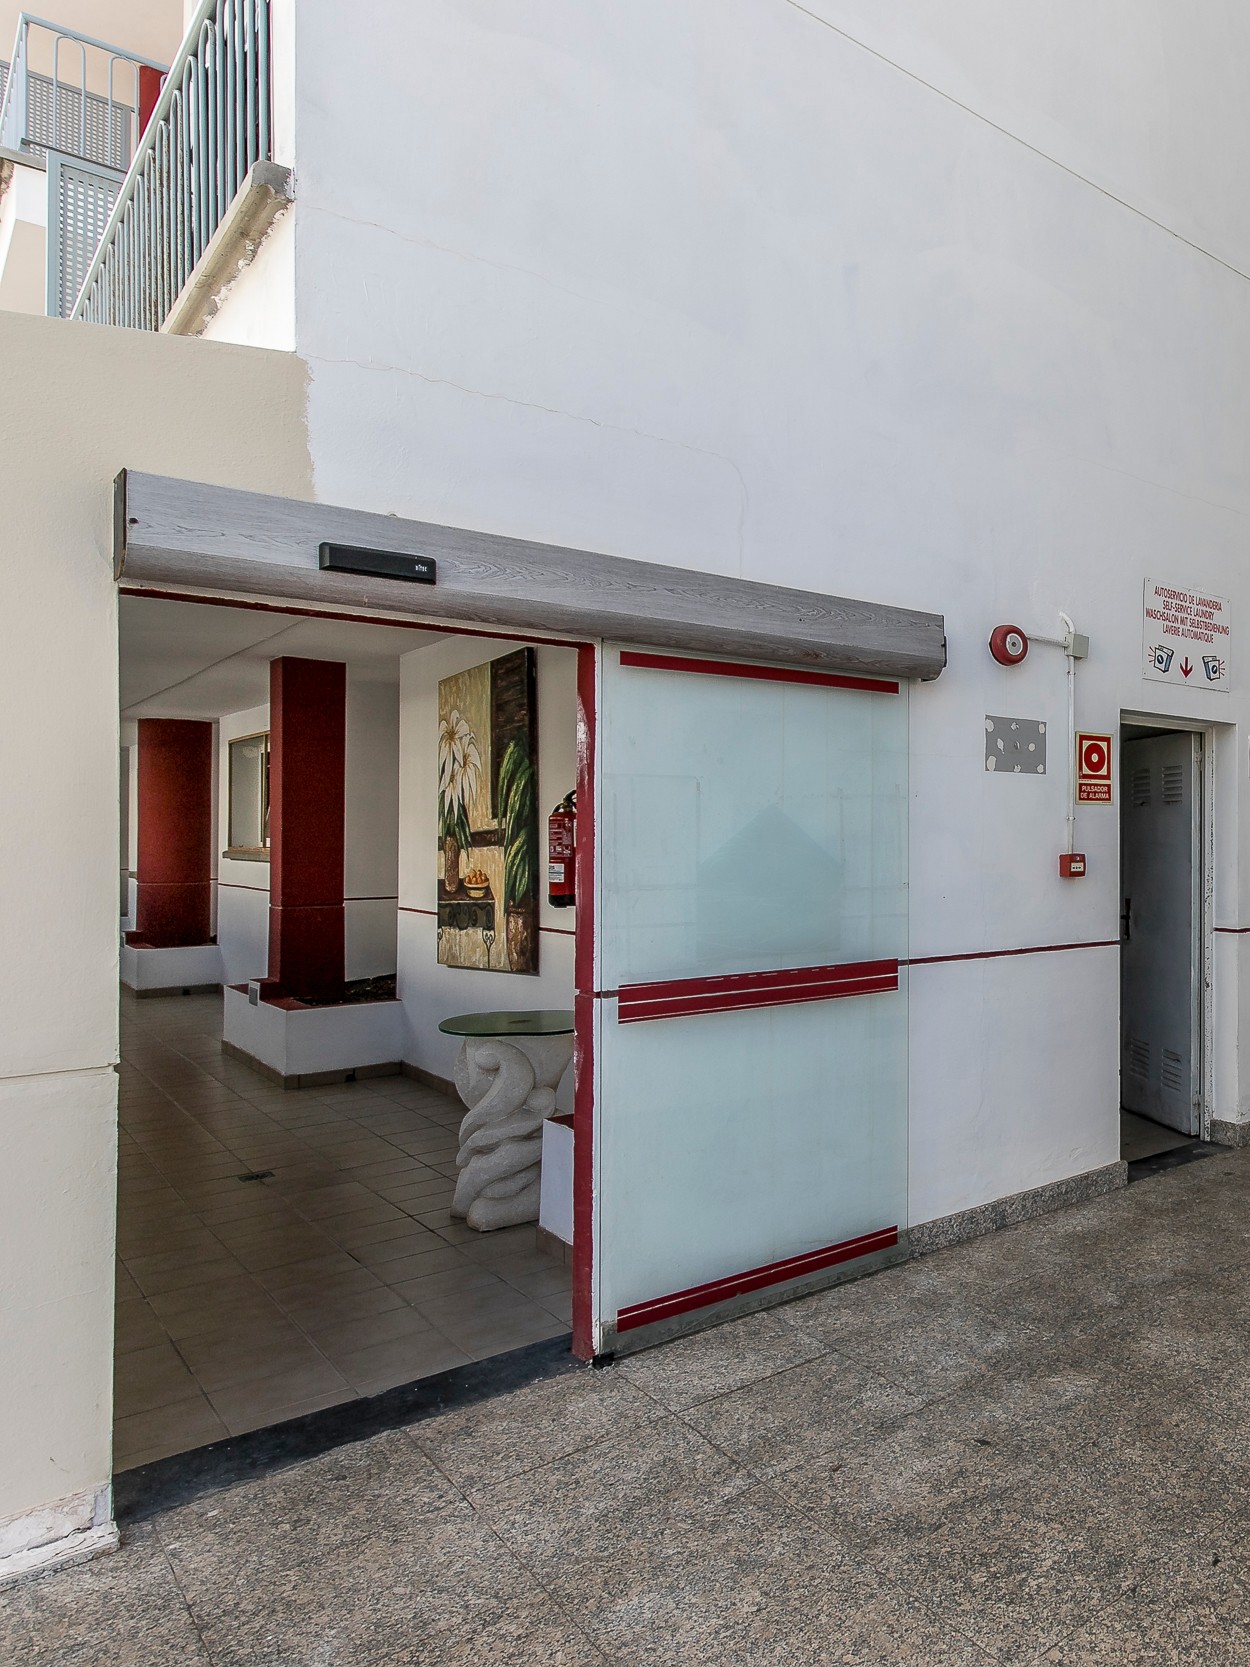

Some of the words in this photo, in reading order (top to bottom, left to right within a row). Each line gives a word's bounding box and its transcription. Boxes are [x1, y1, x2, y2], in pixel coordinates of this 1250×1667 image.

[1154, 585, 1187, 603] AUTOSERVICIO
[1189, 594, 1195, 605] DE
[1163, 600, 1192, 616] SELF-SERVICE
[1194, 607, 1214, 621] LAUNDRY
[1145, 607, 1179, 624] WASCHSALON
[1180, 615, 1188, 627] MIT
[1189, 618, 1229, 636] SELBSTBEDIENUNG
[1163, 623, 1181, 637] LAVERIE
[1181, 628, 1214, 644] AUTOMATIQUE
